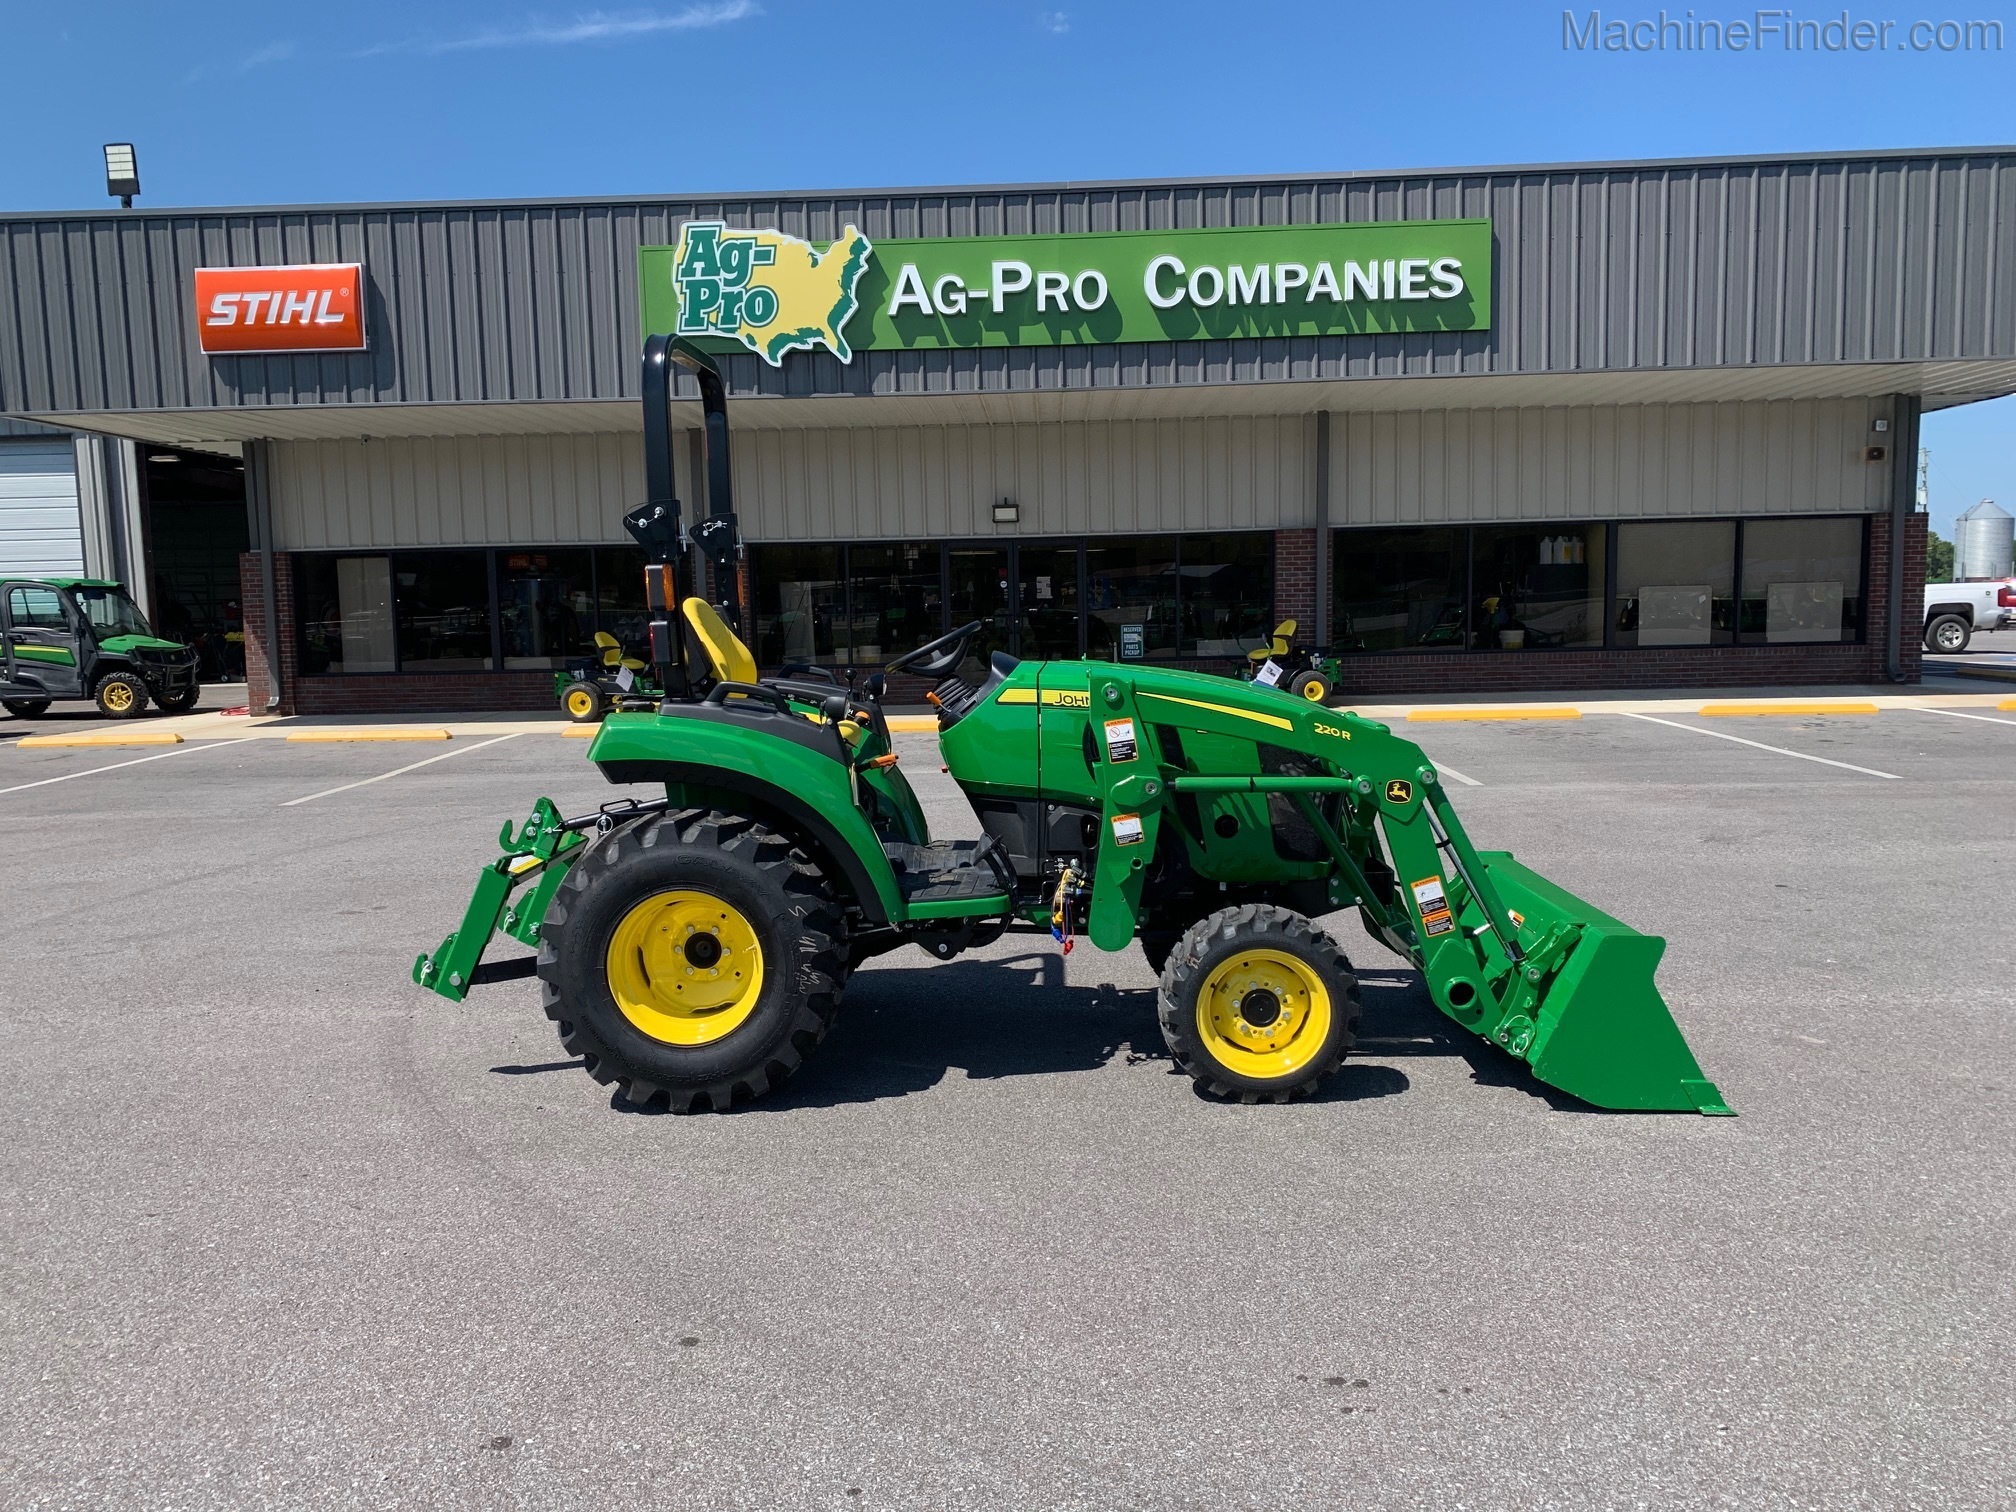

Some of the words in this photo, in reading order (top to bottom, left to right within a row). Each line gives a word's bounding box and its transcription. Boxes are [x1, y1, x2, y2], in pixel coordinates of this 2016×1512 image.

[676, 225, 777, 288] Ag-
[1143, 254, 1464, 309] COMPANIES
[206, 290, 345, 326] STIHL
[679, 279, 779, 331] Pro
